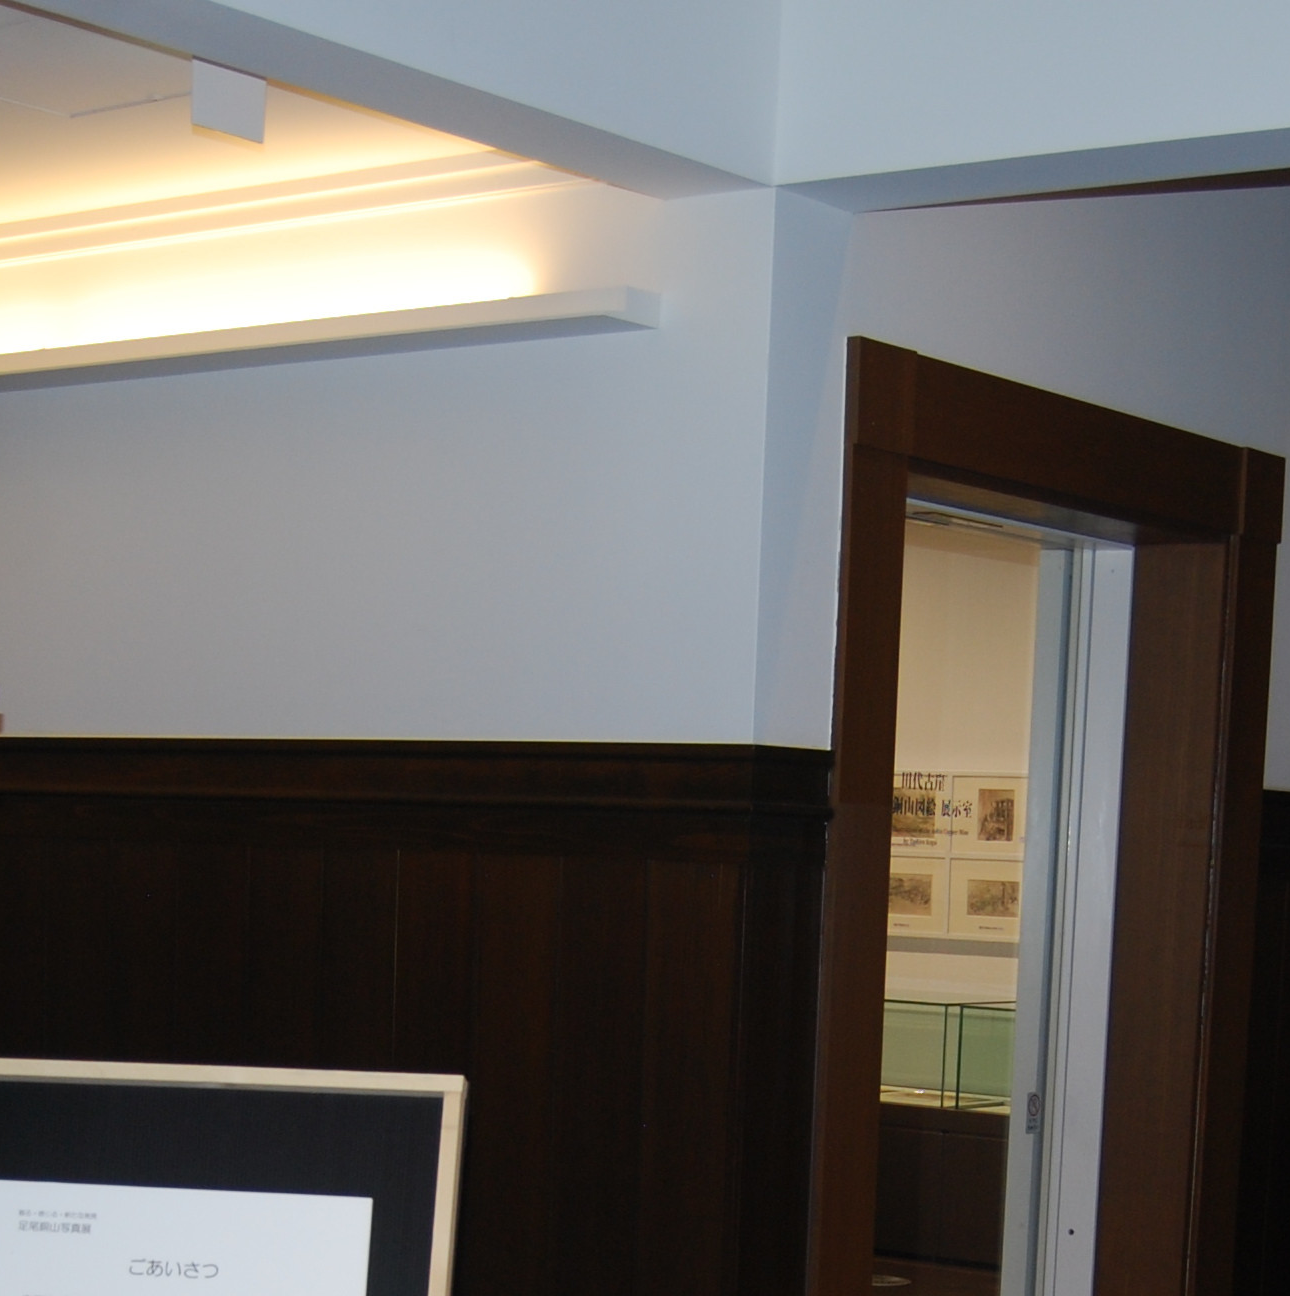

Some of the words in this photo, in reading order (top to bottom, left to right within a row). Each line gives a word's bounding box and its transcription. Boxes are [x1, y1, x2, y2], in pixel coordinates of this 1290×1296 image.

[18, 1220, 92, 1234] 足尾銅山写真展
[128, 1258, 219, 1280] ごあいさつ
